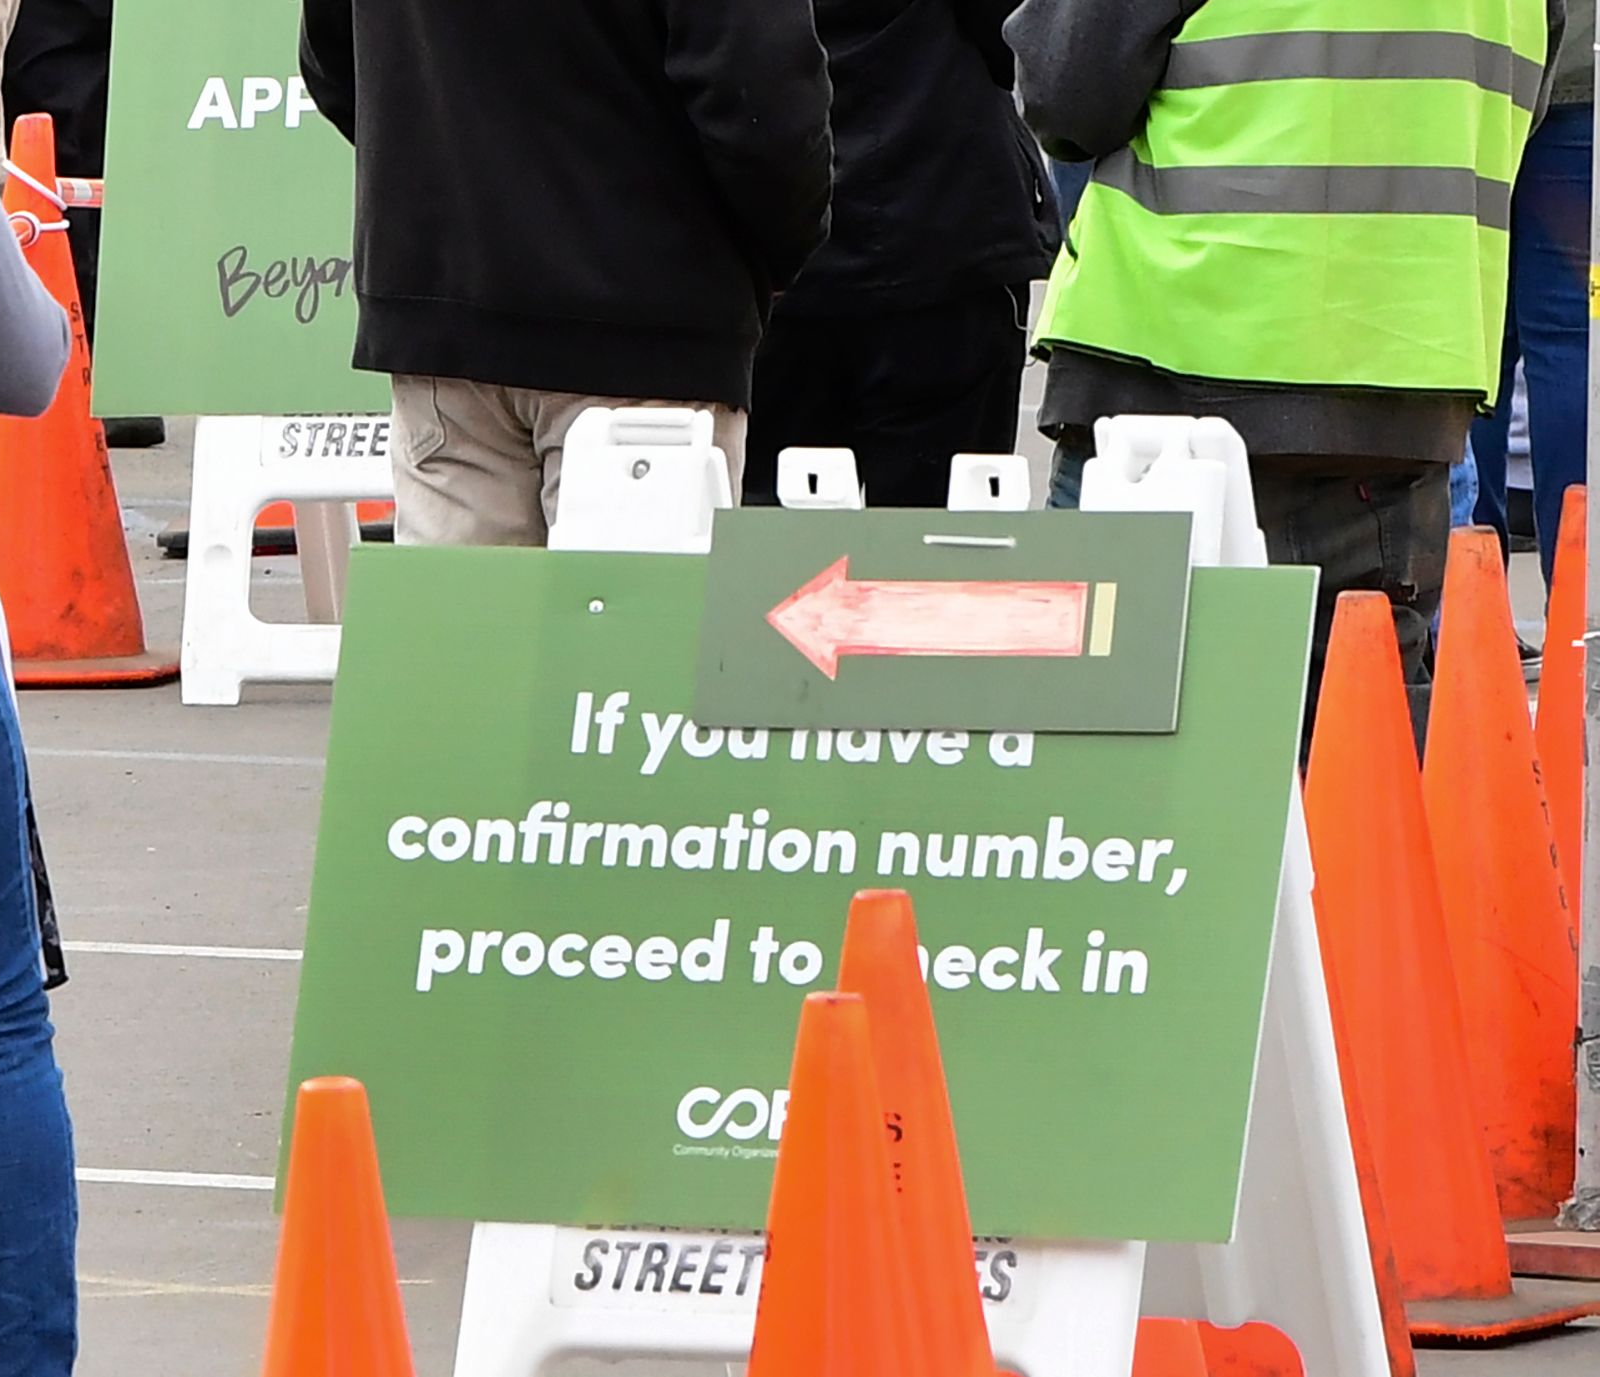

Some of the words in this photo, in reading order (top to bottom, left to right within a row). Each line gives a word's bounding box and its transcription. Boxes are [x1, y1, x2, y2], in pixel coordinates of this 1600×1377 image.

[571, 691, 630, 755] If
[640, 712, 769, 775] you
[988, 733, 1034, 767] a
[387, 801, 856, 874] confirmation
[877, 816, 1188, 897] number,
[416, 918, 730, 992] proceed
[749, 926, 823, 985] to
[920, 928, 1062, 993] eck
[1082, 930, 1149, 994] in
[574, 1237, 766, 1296] STREET
